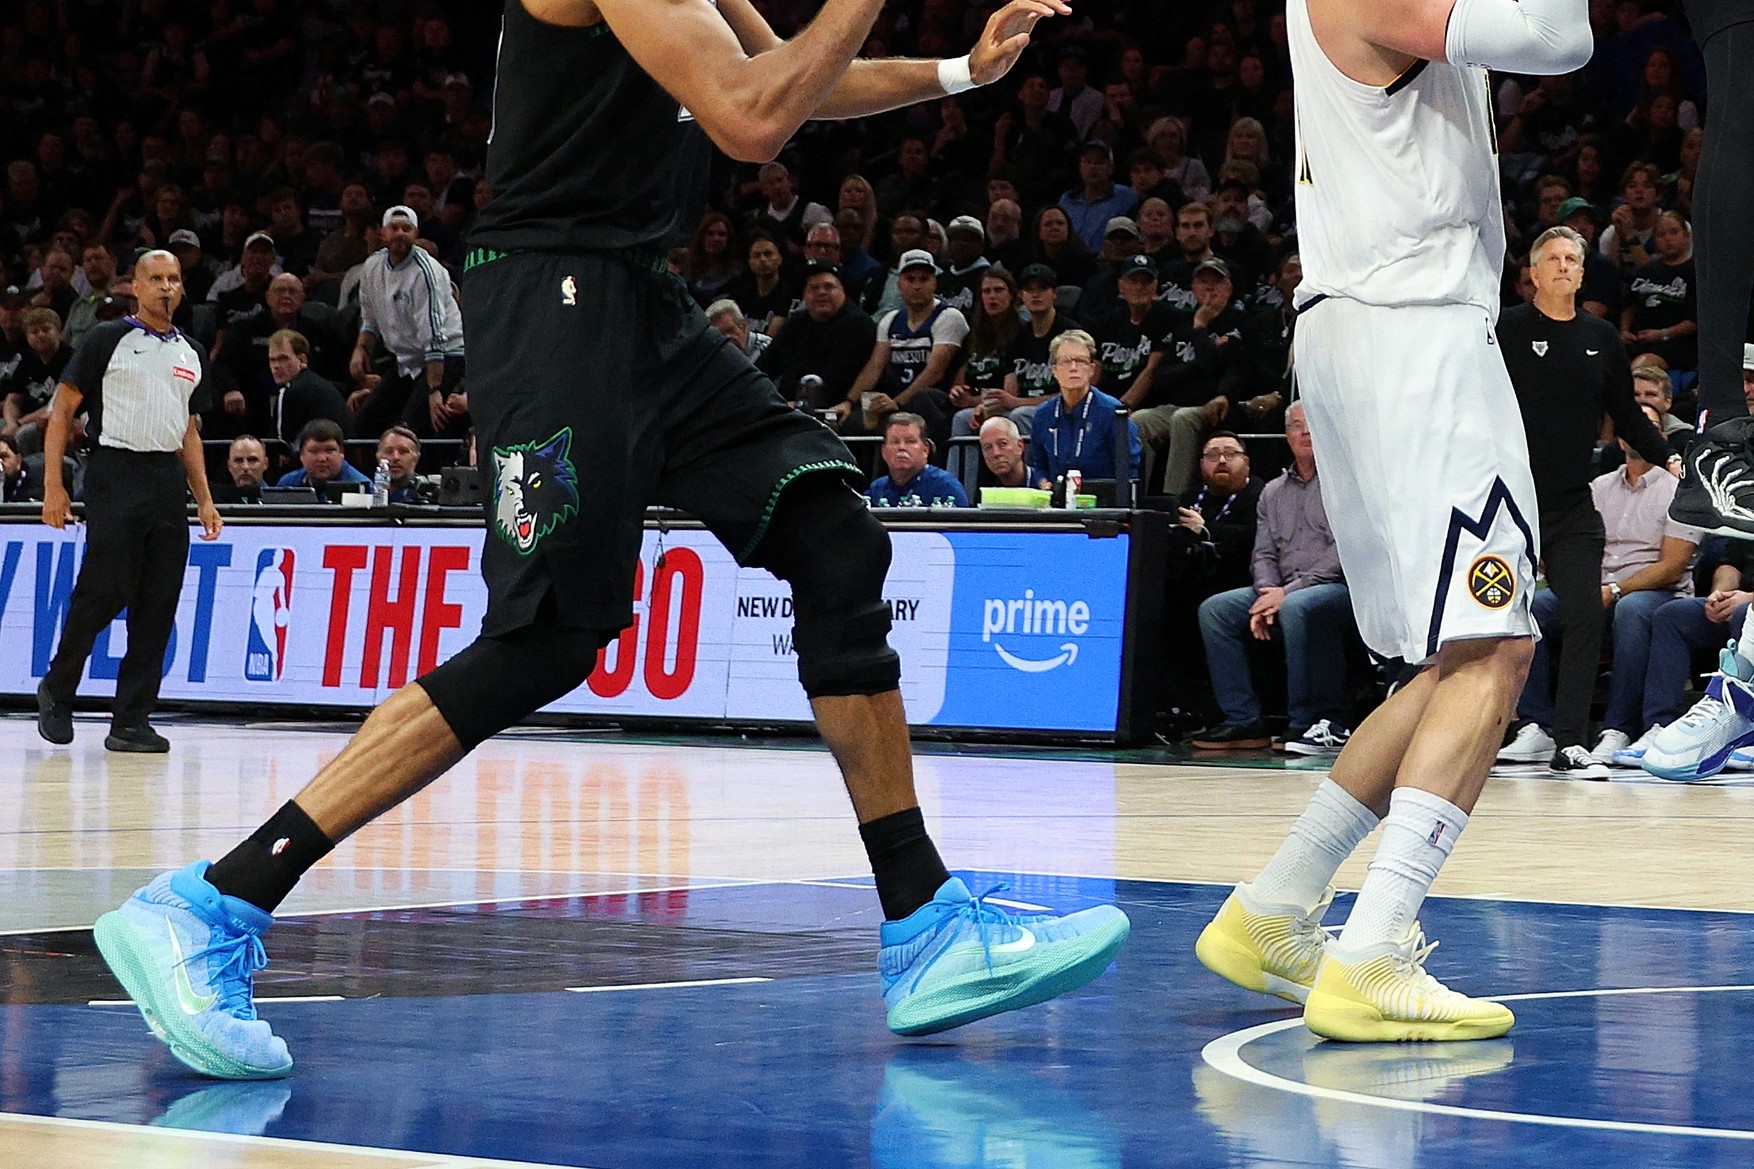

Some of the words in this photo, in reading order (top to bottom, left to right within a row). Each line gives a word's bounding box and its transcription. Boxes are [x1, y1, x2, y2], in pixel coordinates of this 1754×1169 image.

[322, 545, 470, 688] THE
[737, 596, 779, 618] NEW
[982, 588, 1091, 643] prime
[248, 652, 270, 676] NBA
